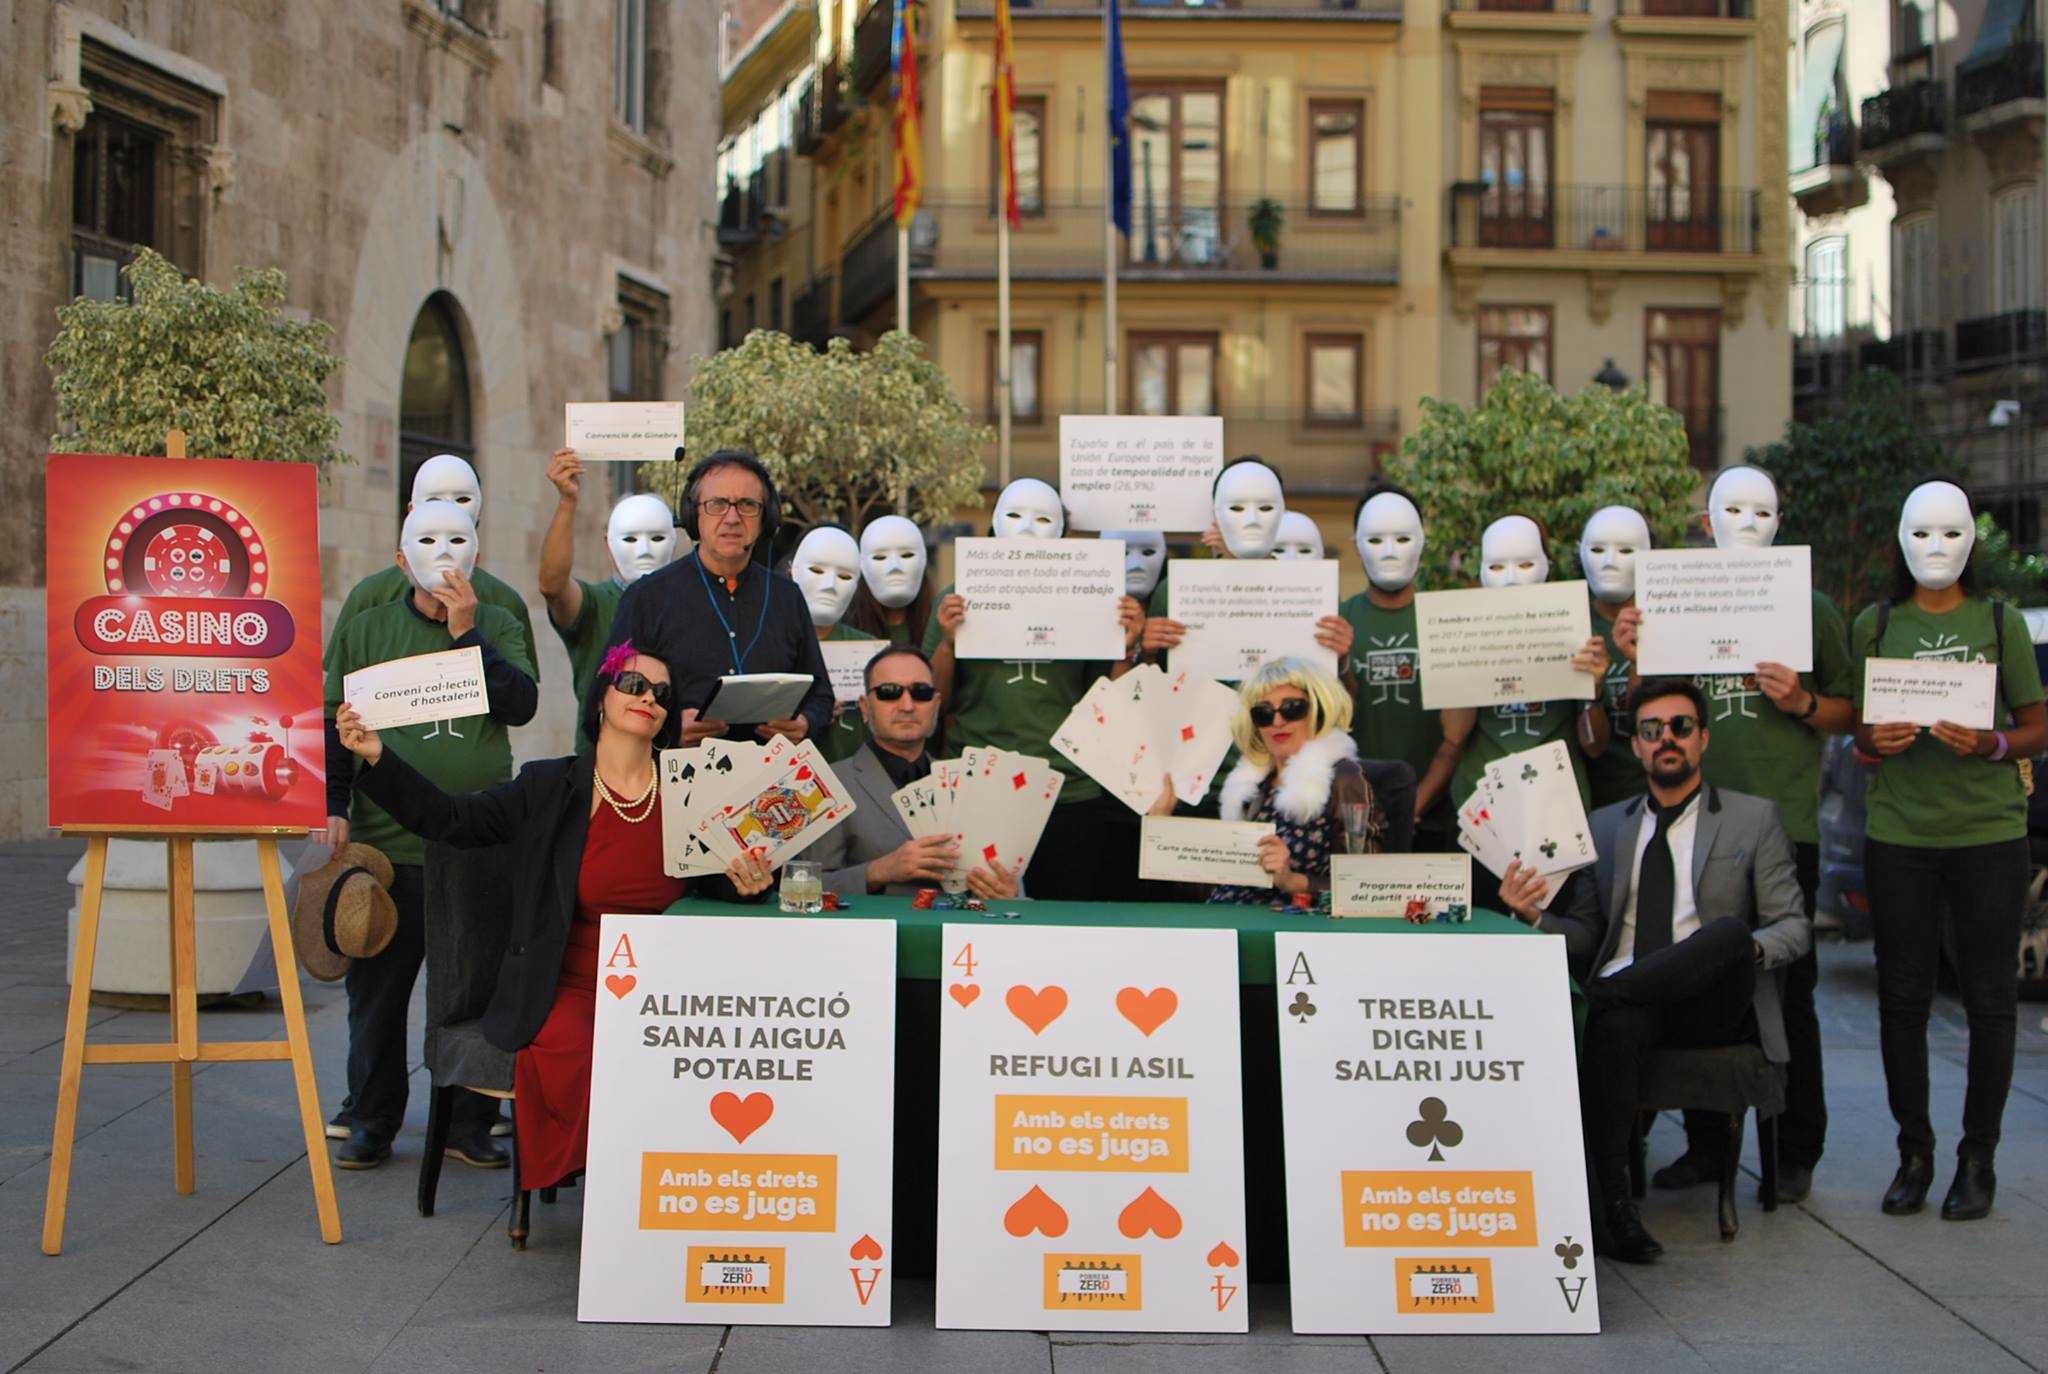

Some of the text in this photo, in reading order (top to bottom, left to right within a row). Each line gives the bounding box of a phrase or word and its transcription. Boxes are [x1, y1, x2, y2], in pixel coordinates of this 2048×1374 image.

[1071, 438, 1108, 450] España
[1136, 438, 1146, 448] el
[1182, 438, 1195, 448] de
[1108, 453, 1150, 464] Europea
[1182, 455, 1214, 464] mayor
[1096, 467, 1108, 476] de
[1112, 467, 1185, 478] temporalidad
[1204, 467, 1214, 477] el
[1072, 480, 1112, 492] empleo
[992, 550, 1006, 560] de
[1008, 550, 1022, 560] 25
[1024, 550, 1072, 560] millones
[1076, 550, 1088, 560] de
[966, 569, 1014, 578] personas
[1033, 568, 1058, 577] todo
[1060, 568, 1072, 577] el
[1074, 568, 1111, 578] mundo
[998, 584, 1054, 596] atrapadas
[1072, 584, 1114, 596] trabajo
[1655, 606, 1666, 614] de
[94, 608, 268, 646] CASINO
[1534, 654, 1544, 663] de
[1546, 653, 1568, 662] cada
[95, 664, 270, 694] DELS DRETS
[374, 685, 422, 701] Conveni
[425, 678, 478, 694] col·lectiu
[707, 746, 716, 760] 4
[968, 754, 976, 766] 5
[668, 758, 678, 774] 10
[1492, 768, 1501, 780] 2
[900, 795, 911, 808] 9
[1156, 844, 1180, 852] Carta
[1202, 848, 1223, 856] drets
[1359, 882, 1465, 892] Programa electoral
[1371, 894, 1402, 902] partit
[606, 933, 638, 969] A
[952, 942, 979, 977] 4
[1286, 951, 1317, 985] A
[640, 992, 850, 1018] ALIMENTACIÓ
[1358, 999, 1494, 1020] TREBALL
[643, 1026, 846, 1050] SANA I AIGUA
[1372, 1030, 1482, 1050] DIGNE I
[673, 1058, 814, 1081] POTABLE
[990, 1054, 1194, 1080] REFUGI I ASIL
[1334, 1060, 1525, 1082] SALARI JUST
[1012, 1110, 1170, 1130] Amb els drets
[1013, 1132, 1170, 1162] no es juga
[659, 1168, 818, 1188] Amb els drets
[1360, 1186, 1517, 1204] Amb els drets
[658, 1190, 816, 1222] no es juga
[1361, 1208, 1518, 1237] no es juga
[722, 1272, 753, 1284] ZERO
[850, 1268, 882, 1306] A
[1080, 1280, 1110, 1291] ZERO
[1210, 1275, 1238, 1312] 4
[1432, 1284, 1462, 1295] ZERO
[1556, 1277, 1588, 1313] A
